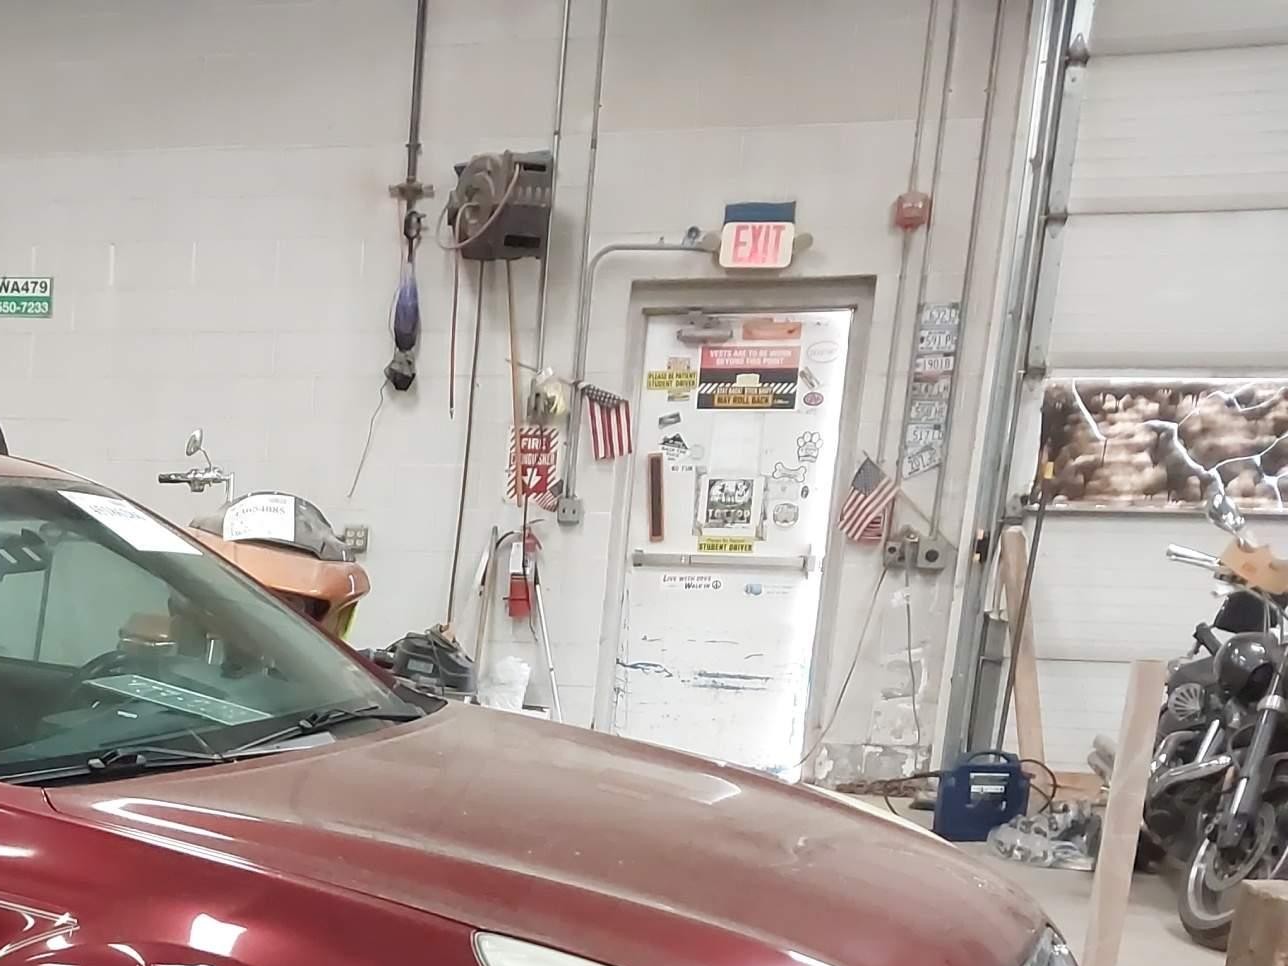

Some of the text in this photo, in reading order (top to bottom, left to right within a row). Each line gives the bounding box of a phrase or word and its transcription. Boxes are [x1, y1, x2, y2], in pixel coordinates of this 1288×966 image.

[732, 224, 786, 264] EXIT
[748, 349, 758, 357] TO
[675, 379, 695, 387] DRIVER
[717, 395, 731, 404] MAY
[732, 395, 749, 404] ROLL
[751, 395, 769, 404] BACK
[699, 543, 727, 551] STUDENT
